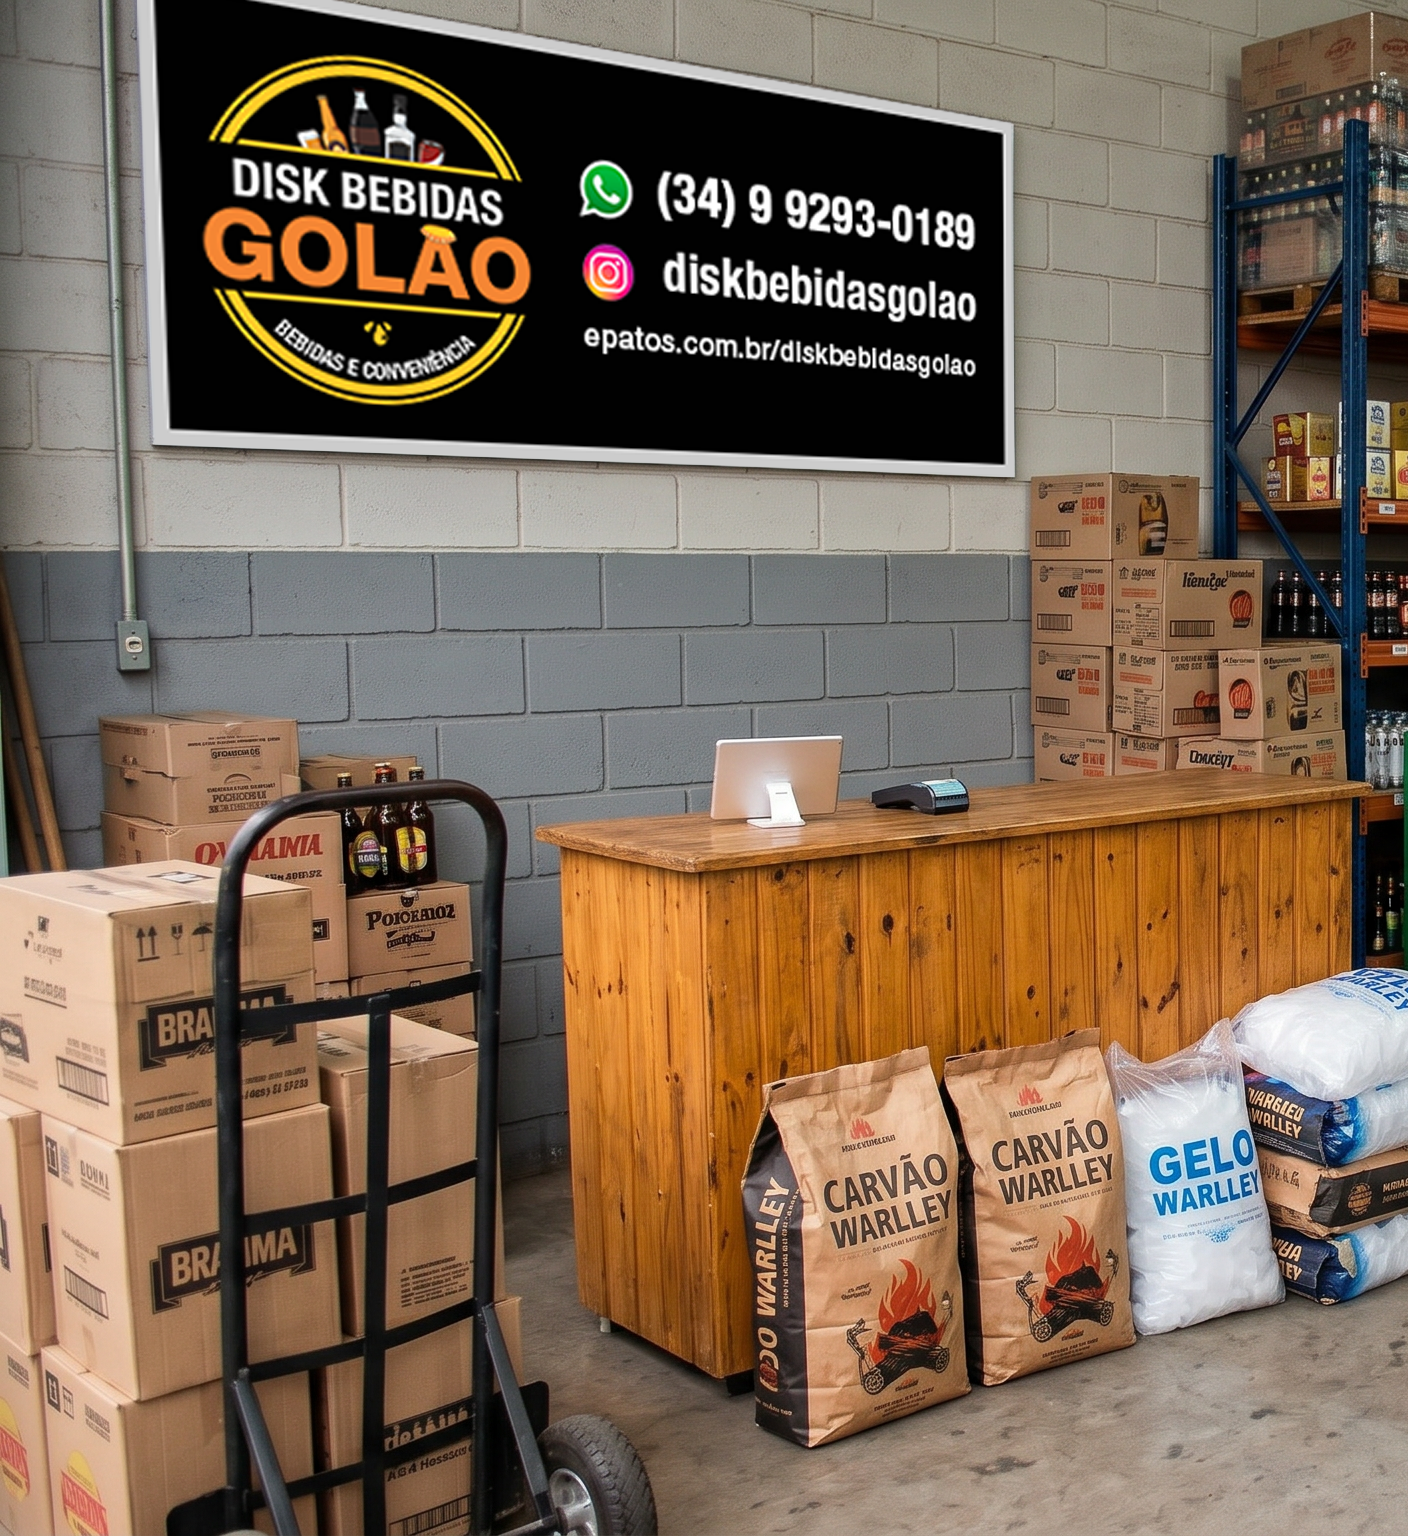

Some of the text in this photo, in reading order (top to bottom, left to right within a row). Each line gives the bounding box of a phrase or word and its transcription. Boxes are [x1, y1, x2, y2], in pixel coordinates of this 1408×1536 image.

[232, 157, 504, 227] DISK BEBIDAS
[657, 171, 976, 251] (34) 9 9293-0189
[662, 252, 977, 323] diskbebidasgolao
[274, 318, 477, 380] BEBIDAS E CONVENIÊNCIA
[991, 1118, 1109, 1172] CARVÃO
[1149, 1129, 1254, 1185] GELO
[823, 1153, 948, 1214] CARVÃO
[998, 1153, 1113, 1205] WARLLEY
[1152, 1169, 1259, 1217] WARLLEY
[755, 1176, 790, 1318] WARLLEY
[830, 1189, 952, 1249] WARLLEY
